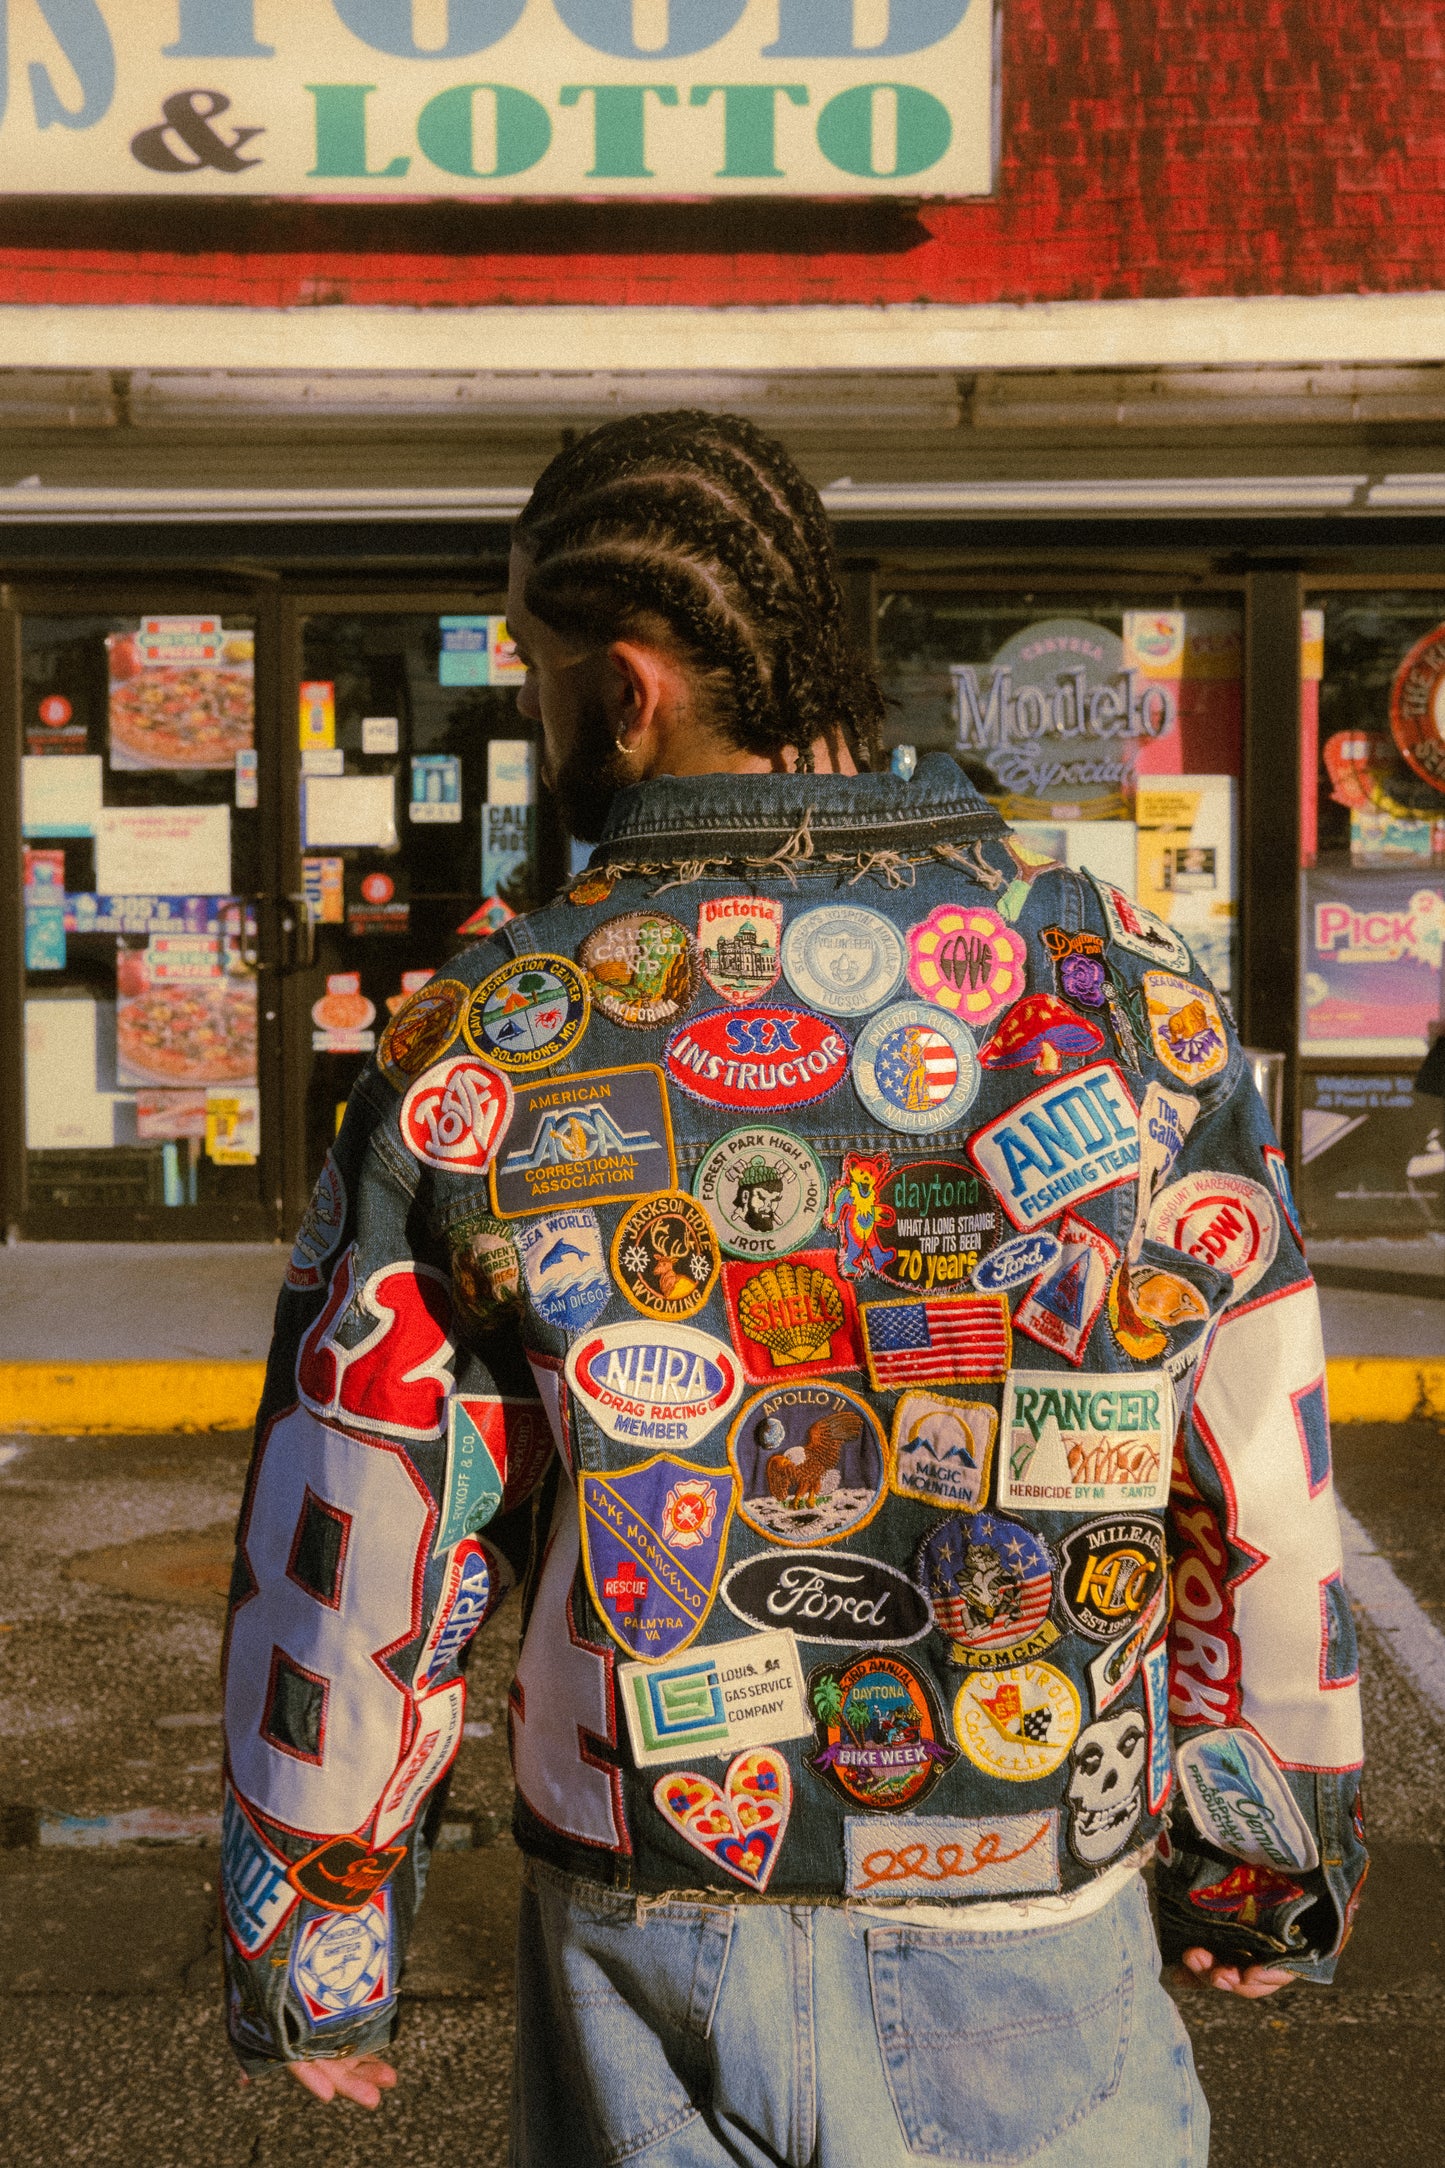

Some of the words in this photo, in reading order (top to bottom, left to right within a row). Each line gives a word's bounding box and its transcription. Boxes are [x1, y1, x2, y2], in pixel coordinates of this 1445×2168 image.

[130, 89, 266, 173] &
[304, 82, 953, 178] LOTTO
[951, 663, 1180, 751] Modelo
[705, 902, 776, 923] Victoria
[1319, 906, 1417, 946] PICK
[594, 944, 682, 961] Canyon
[604, 927, 673, 945] Kings
[940, 936, 993, 990] LOVE
[469, 1006, 483, 1038] NAVY
[477, 960, 546, 1007] RECREATION
[550, 963, 582, 1003] CENTER
[602, 995, 680, 1021] CALIFORNIA
[726, 1018, 801, 1056] SEX
[868, 1009, 918, 1047] PUERTO
[928, 1012, 960, 1041] RICO
[671, 1035, 848, 1091] INSTRUCTOR
[528, 1083, 612, 1113] AMERICAN
[883, 1103, 957, 1127] NATIONAL
[954, 1053, 973, 1102] GUARD
[992, 1072, 1138, 1201] ANDE
[525, 1153, 639, 1183] CORRECTIONAL
[530, 1168, 636, 1197] ASSOCIATION
[701, 1154, 727, 1201] FOREST
[728, 1134, 765, 1154] PARK
[769, 1137, 802, 1160] HIGH
[893, 1173, 979, 1217] daytona
[1018, 1161, 1100, 1220] FISHING
[1159, 1186, 1192, 1231] DISCOUNT
[1193, 1178, 1256, 1200] WAREHOUSE
[519, 1231, 544, 1252] SEA
[549, 1213, 594, 1233] WORLD
[626, 1198, 686, 1241] JACKSON
[687, 1205, 712, 1253] HOLE
[728, 1234, 776, 1253] JROTC
[897, 1217, 922, 1238] WHAT
[932, 1214, 957, 1235] LONG
[957, 1211, 997, 1232] STRANGE
[918, 1236, 940, 1255] TRIP
[941, 1235, 957, 1253] ITS
[958, 1232, 982, 1252] BEEN
[1188, 1205, 1245, 1267] CDW
[898, 1250, 922, 1283] 70
[924, 1249, 979, 1289] years
[993, 1242, 1044, 1281] Ford
[542, 1299, 567, 1318] SAN
[570, 1287, 604, 1311] DIEGO
[631, 1281, 703, 1314] WYOMING
[749, 1293, 839, 1333] SHELL
[599, 1346, 711, 1402] NHRA
[600, 1389, 645, 1418] DRAG
[650, 1400, 709, 1420] RACING
[762, 1390, 828, 1416] APOLLO
[831, 1396, 848, 1413] 11
[1011, 1385, 1162, 1444] RANGER
[613, 1413, 690, 1440] MEMBER
[461, 1458, 474, 1469] &
[915, 1461, 962, 1484] MAGIC
[453, 1473, 472, 1522] RYKOFF
[900, 1473, 974, 1502] MOUNTAIN
[1009, 1483, 1073, 1499] HERBICIDE
[1074, 1486, 1092, 1500] BY
[592, 1489, 624, 1526] LAKE
[626, 1524, 702, 1609] MONTICELLO
[604, 1580, 647, 1596] RESCUE
[766, 1565, 891, 1627] Ford
[431, 1568, 490, 1668] NHRA
[622, 1616, 684, 1631] PALMYRA
[645, 1629, 661, 1642] VA
[963, 1632, 1050, 1667] TOMCAT
[724, 1687, 748, 1704] GAS
[748, 1677, 793, 1699] SERVICE
[851, 1684, 906, 1701] DAYTONA
[868, 1659, 915, 1689] ANNUAL
[728, 1700, 785, 1724] COMPANY
[979, 1668, 1074, 1736] CHEVROLET
[838, 1750, 878, 1766] BIKE
[879, 1745, 929, 1766] WEEK
[963, 1709, 1050, 1771] Corvette
[1209, 1786, 1247, 1842] ASPHALT
